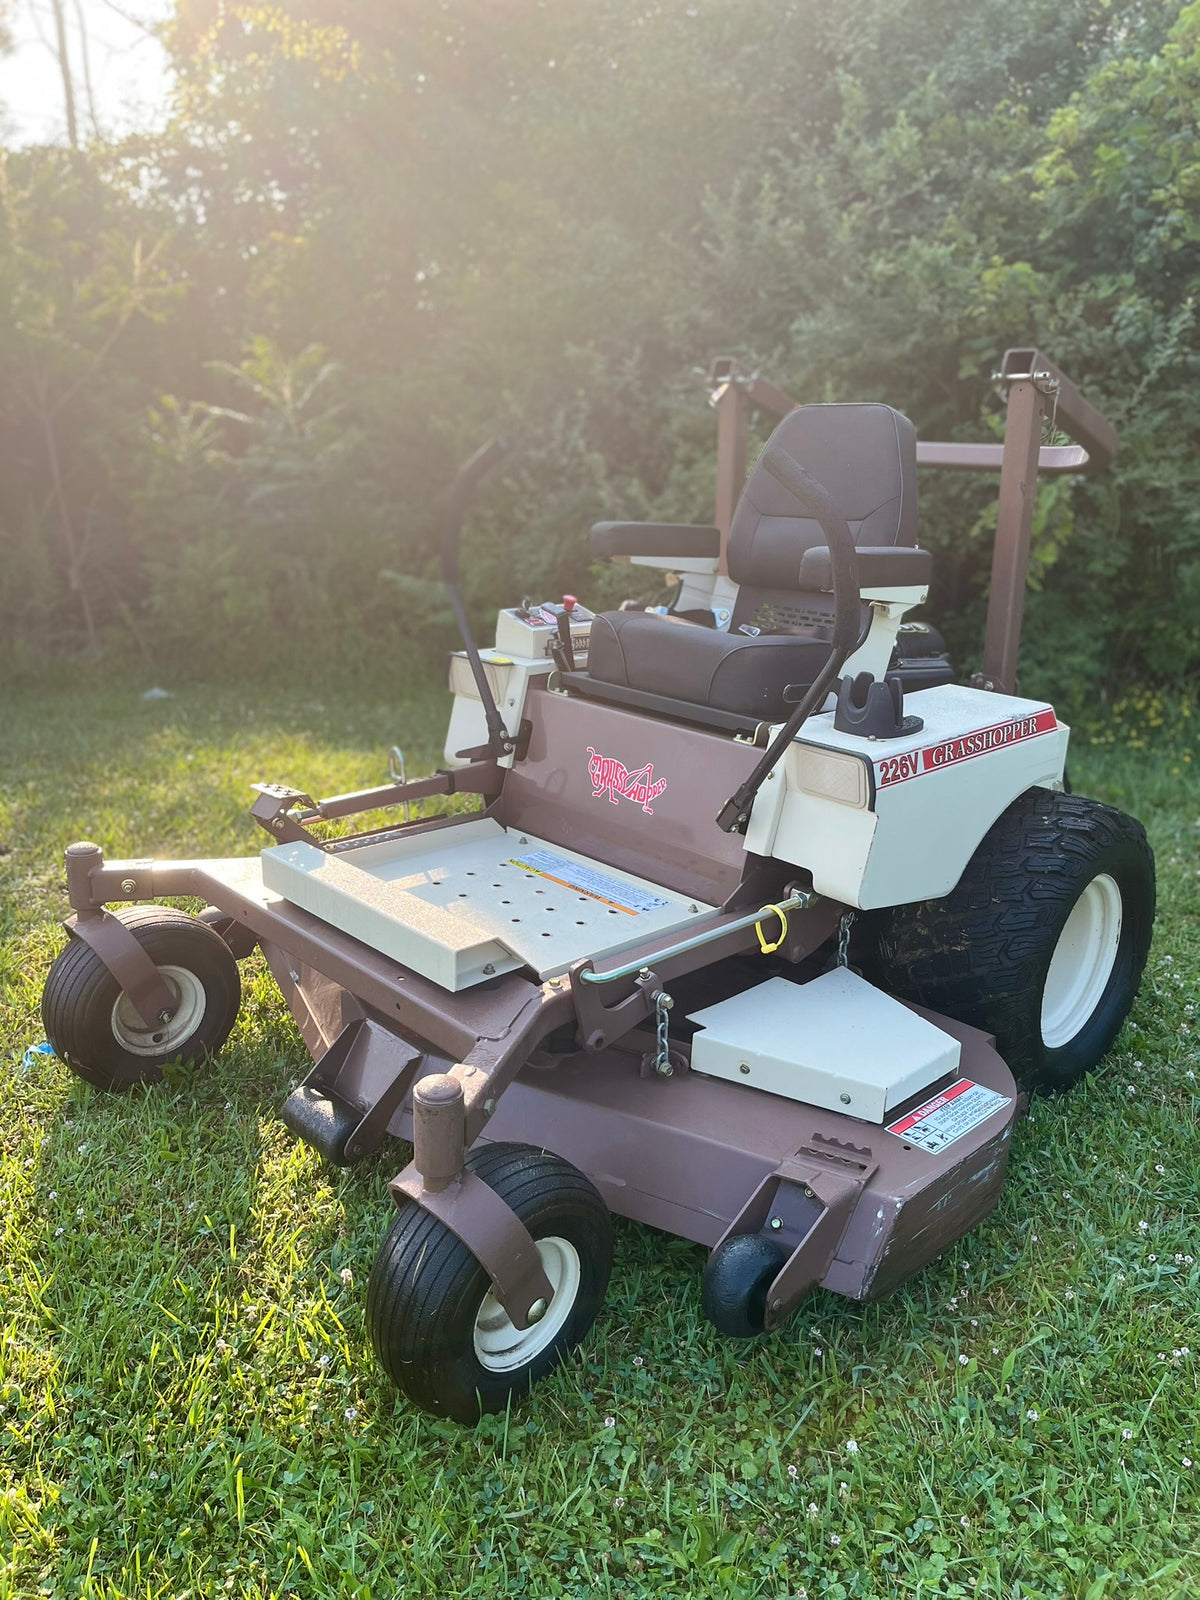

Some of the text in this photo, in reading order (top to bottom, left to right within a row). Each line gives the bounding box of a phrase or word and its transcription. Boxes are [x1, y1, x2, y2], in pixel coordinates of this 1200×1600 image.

[880, 717, 1037, 785] 226V GRASSHOPPER
[919, 1096, 949, 1117] DANGER
